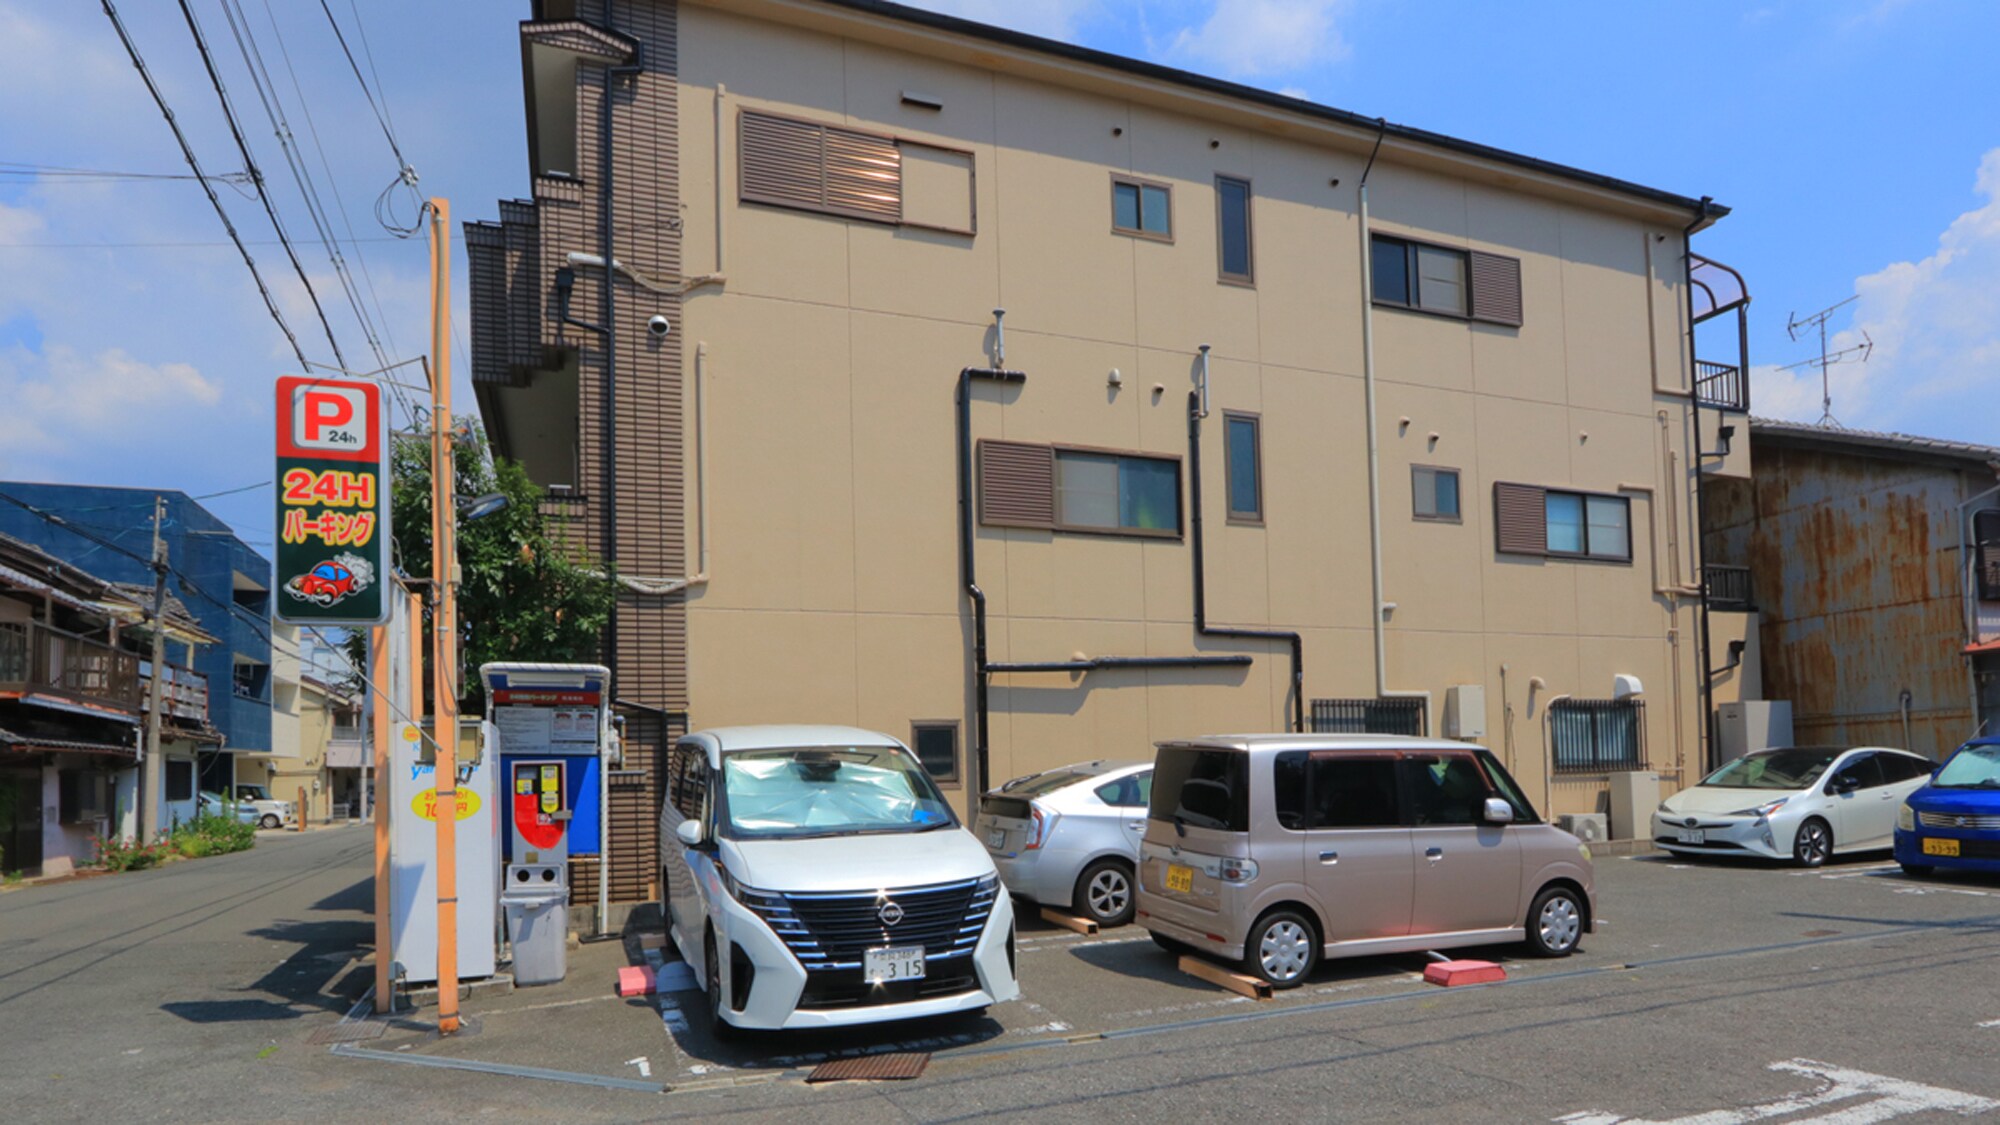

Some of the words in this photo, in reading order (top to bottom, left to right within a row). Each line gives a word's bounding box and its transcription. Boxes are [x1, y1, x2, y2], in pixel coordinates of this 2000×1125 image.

[304, 392, 353, 441] P
[328, 430, 357, 444] 24h
[283, 469, 375, 508] 24H
[282, 509, 375, 546] パーキング
